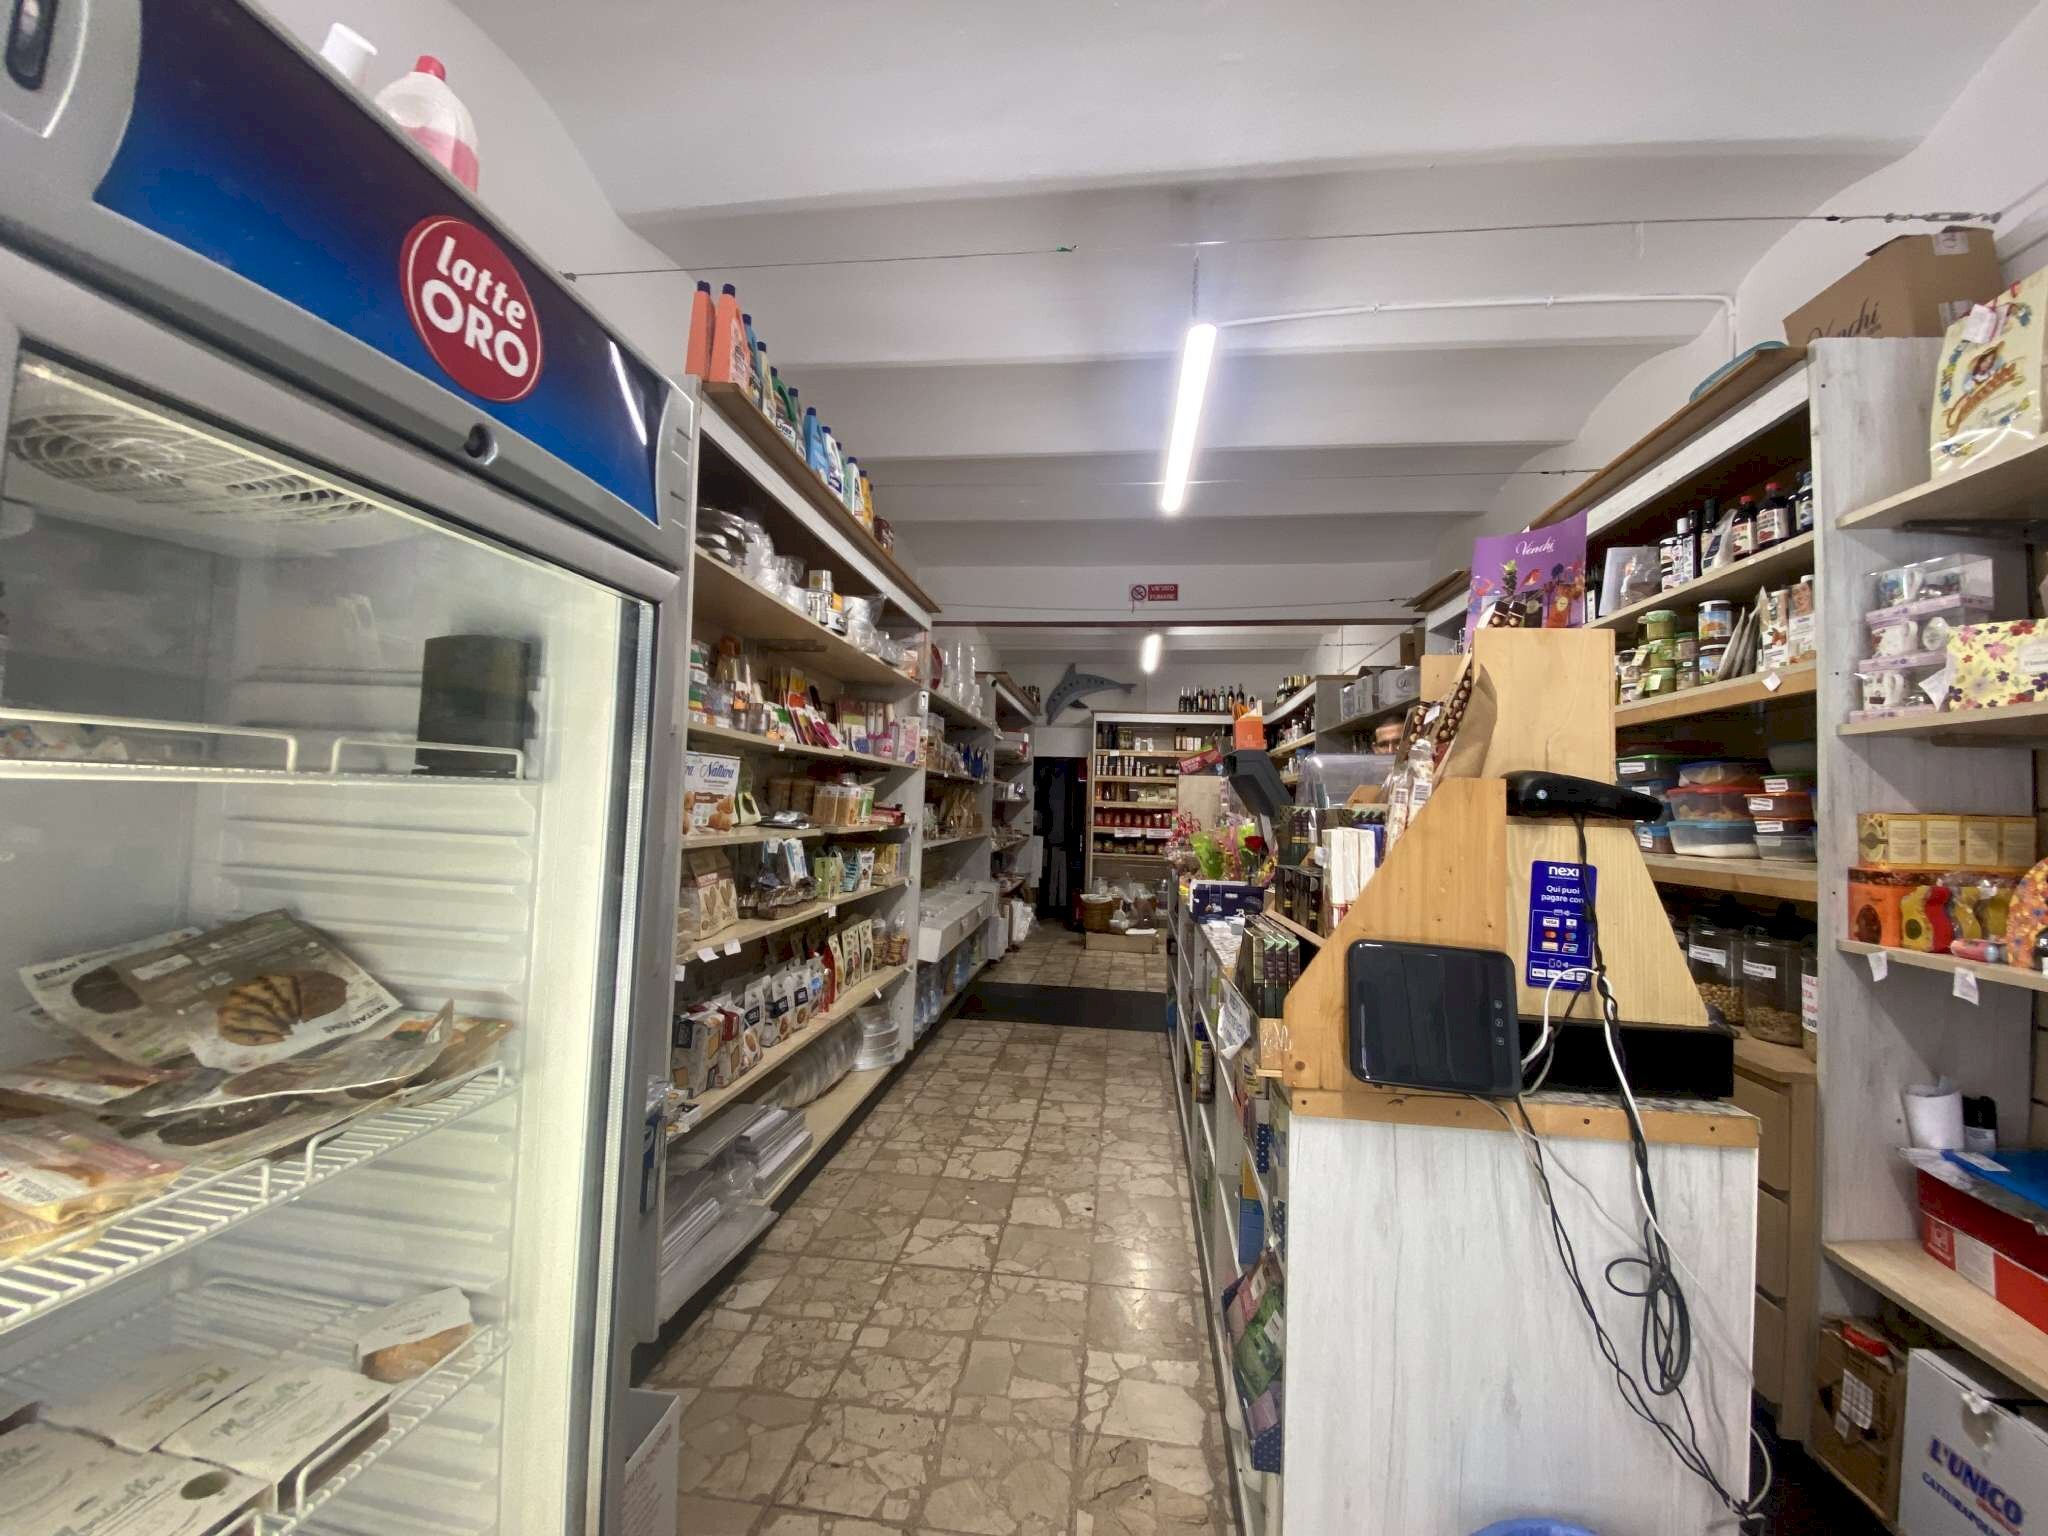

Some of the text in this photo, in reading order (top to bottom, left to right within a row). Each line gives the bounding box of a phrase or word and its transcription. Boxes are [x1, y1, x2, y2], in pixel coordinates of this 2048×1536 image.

[421, 278, 529, 378] ORO
[1515, 536, 1556, 556] Venchi
[1548, 866, 1579, 877] nexi
[1546, 885, 1560, 893] Qui
[1541, 894, 1568, 903] pagare
[1929, 1437, 2023, 1525] L'UNICO
